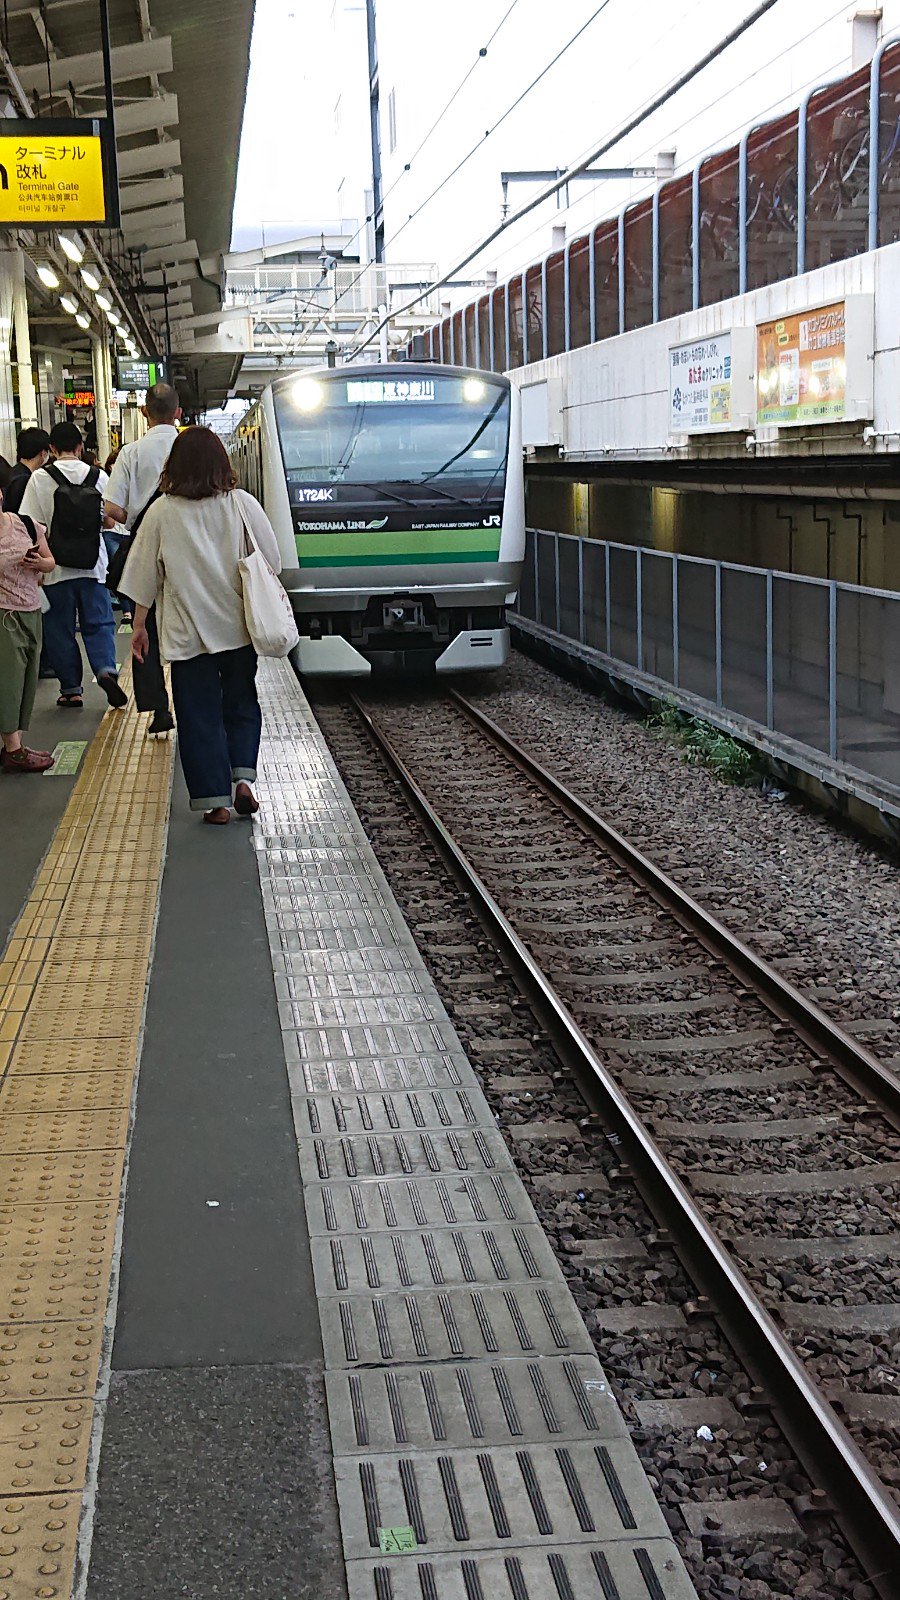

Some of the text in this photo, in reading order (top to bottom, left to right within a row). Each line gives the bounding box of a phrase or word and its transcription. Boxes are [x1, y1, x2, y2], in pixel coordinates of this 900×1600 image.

[15, 146, 86, 160] ターミナル
[16, 164, 47, 180] 改札
[18, 182, 79, 191] Terminal Gate
[157, 363, 164, 378] 1
[298, 488, 333, 501] 1724K
[297, 520, 366, 531] YOKOHAMA LINE
[483, 515, 500, 527] JR
